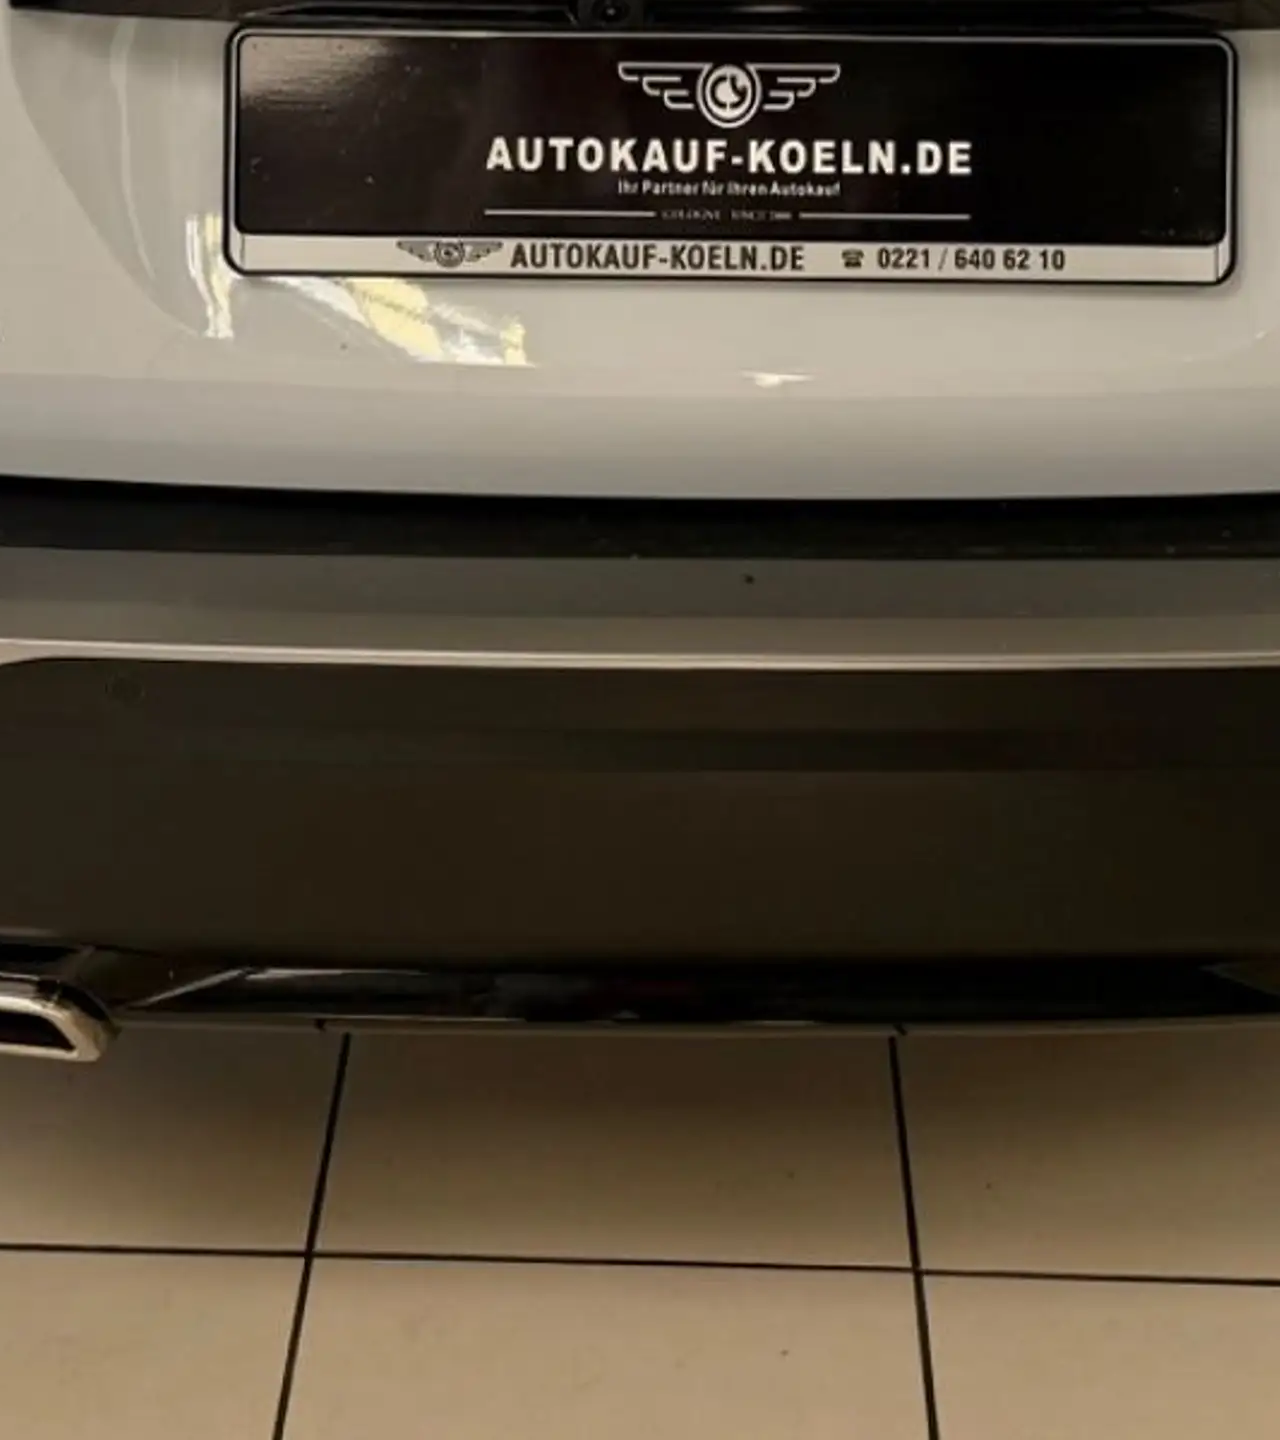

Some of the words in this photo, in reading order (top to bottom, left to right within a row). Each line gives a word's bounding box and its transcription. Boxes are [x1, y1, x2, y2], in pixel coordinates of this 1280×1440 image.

[485, 135, 973, 176] AUTOKAUF-KOELN.DE
[617, 179, 639, 195] Ihr
[642, 179, 700, 196] Partner
[702, 180, 725, 197] für
[727, 180, 768, 197] Ihren
[770, 180, 841, 198] Autokauf
[510, 242, 805, 272] AUTOKAUF-KOELN.DE
[877, 246, 930, 270] 0221
[954, 247, 996, 271] 640
[1002, 248, 1031, 271] 62
[1039, 248, 1067, 272] 10
